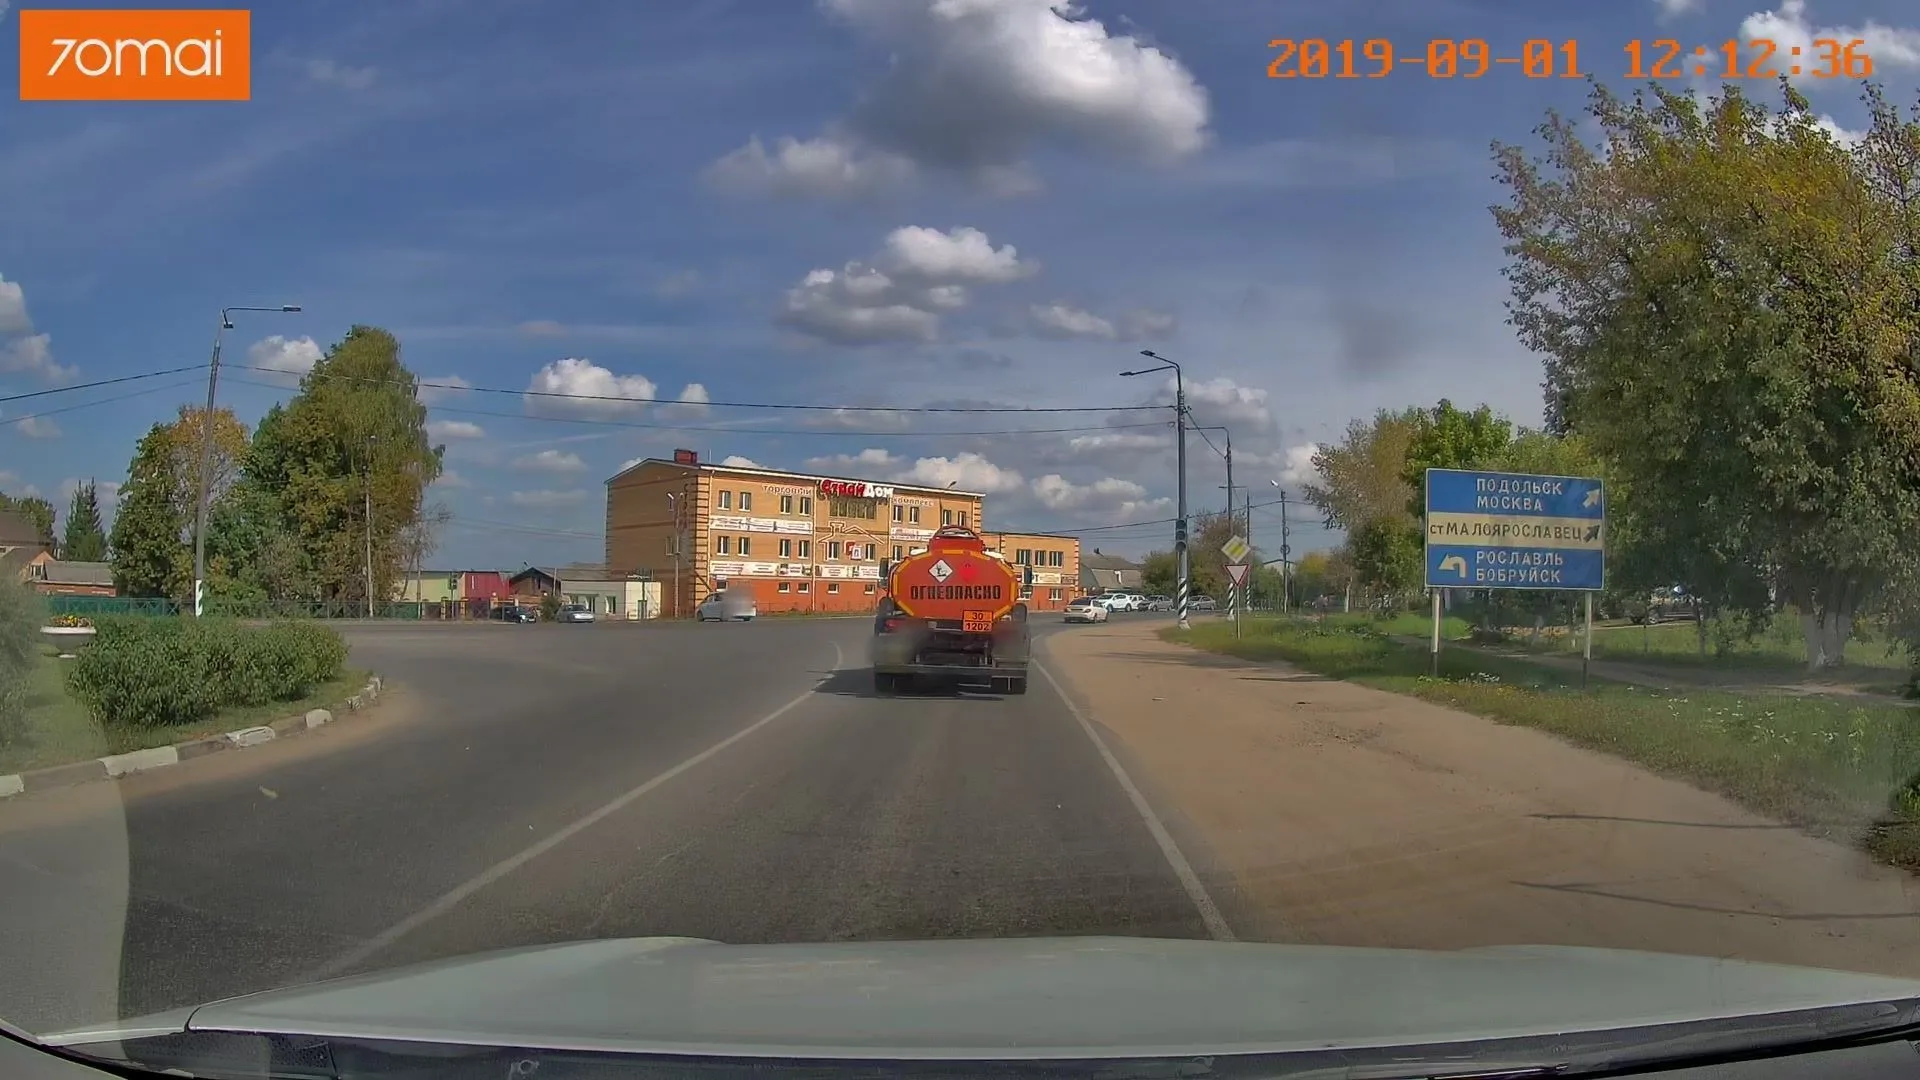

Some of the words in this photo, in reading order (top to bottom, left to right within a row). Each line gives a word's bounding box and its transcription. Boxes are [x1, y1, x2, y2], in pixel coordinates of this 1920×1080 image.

[1476, 478, 1563, 495] ПОДОЛЬСК
[1476, 496, 1543, 512] МОСКВА
[1476, 551, 1563, 566] РОСЛАВЛЬ
[1476, 567, 1561, 583] БОБРУЙСК
[910, 585, 1001, 600] ОГНЕОПАСНО
[972, 612, 984, 621] 30
[966, 622, 990, 631] 1202
